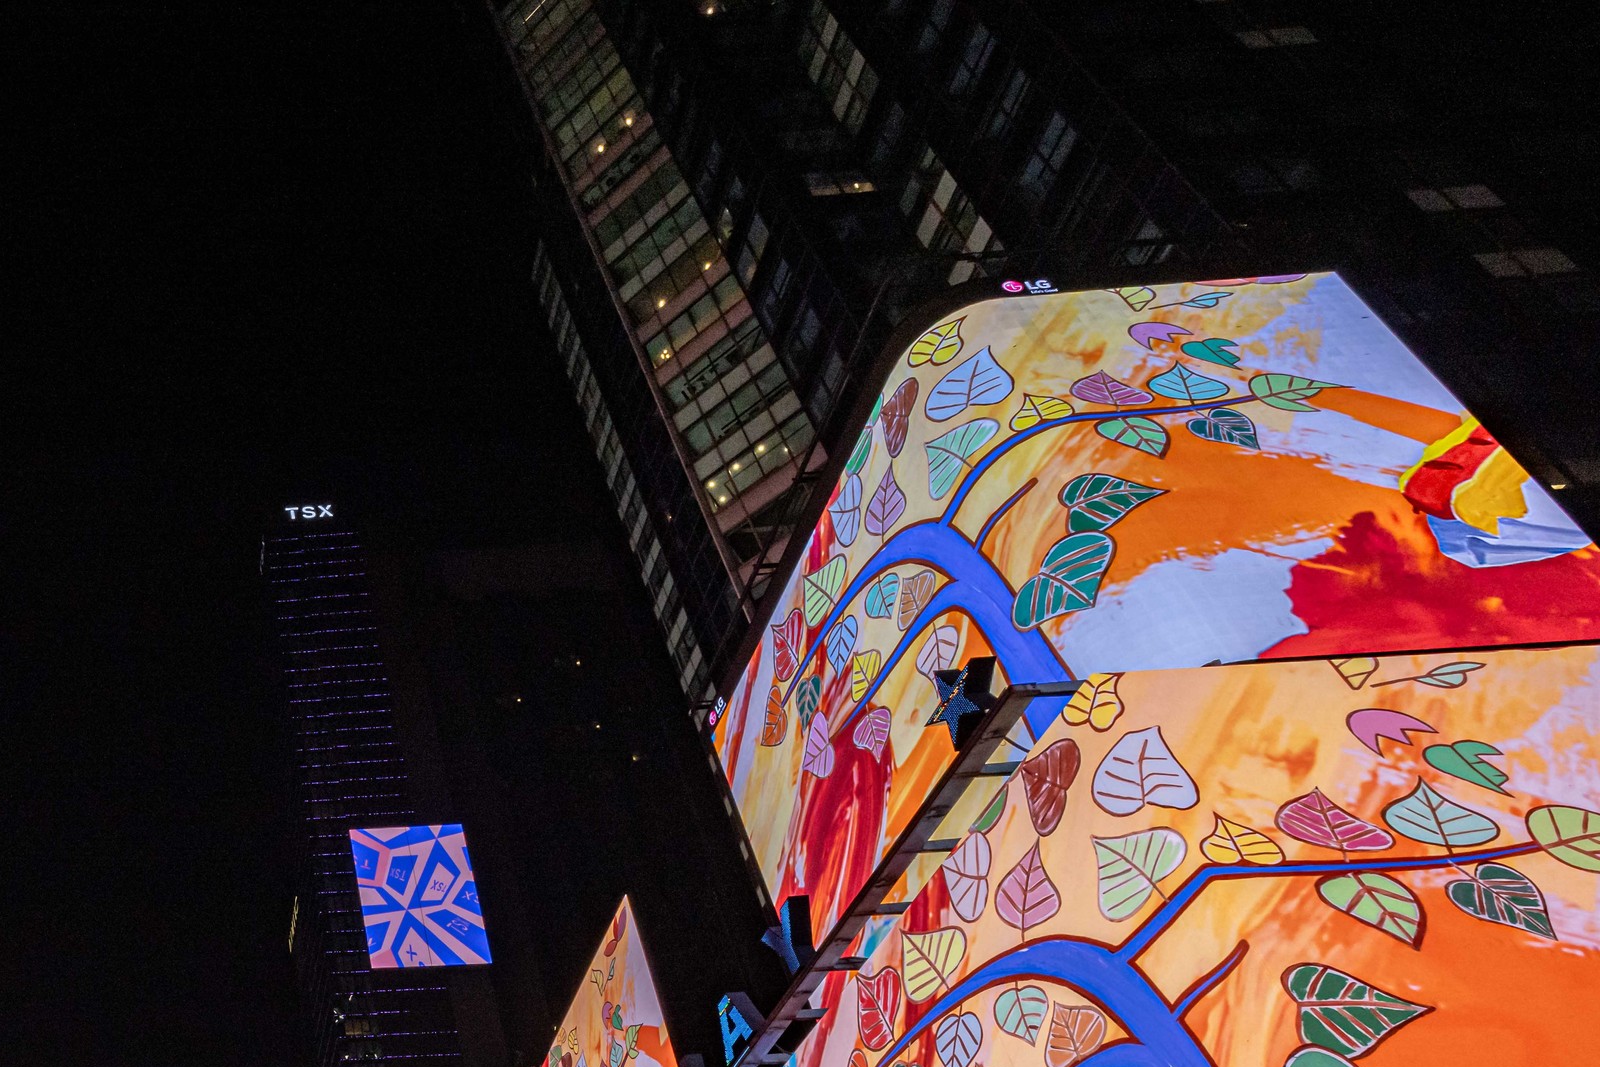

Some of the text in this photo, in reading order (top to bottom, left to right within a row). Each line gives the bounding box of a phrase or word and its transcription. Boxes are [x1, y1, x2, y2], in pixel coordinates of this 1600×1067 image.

[1024, 280, 1051, 290] LG
[285, 504, 333, 519] TSX
[430, 880, 447, 893] TSX
